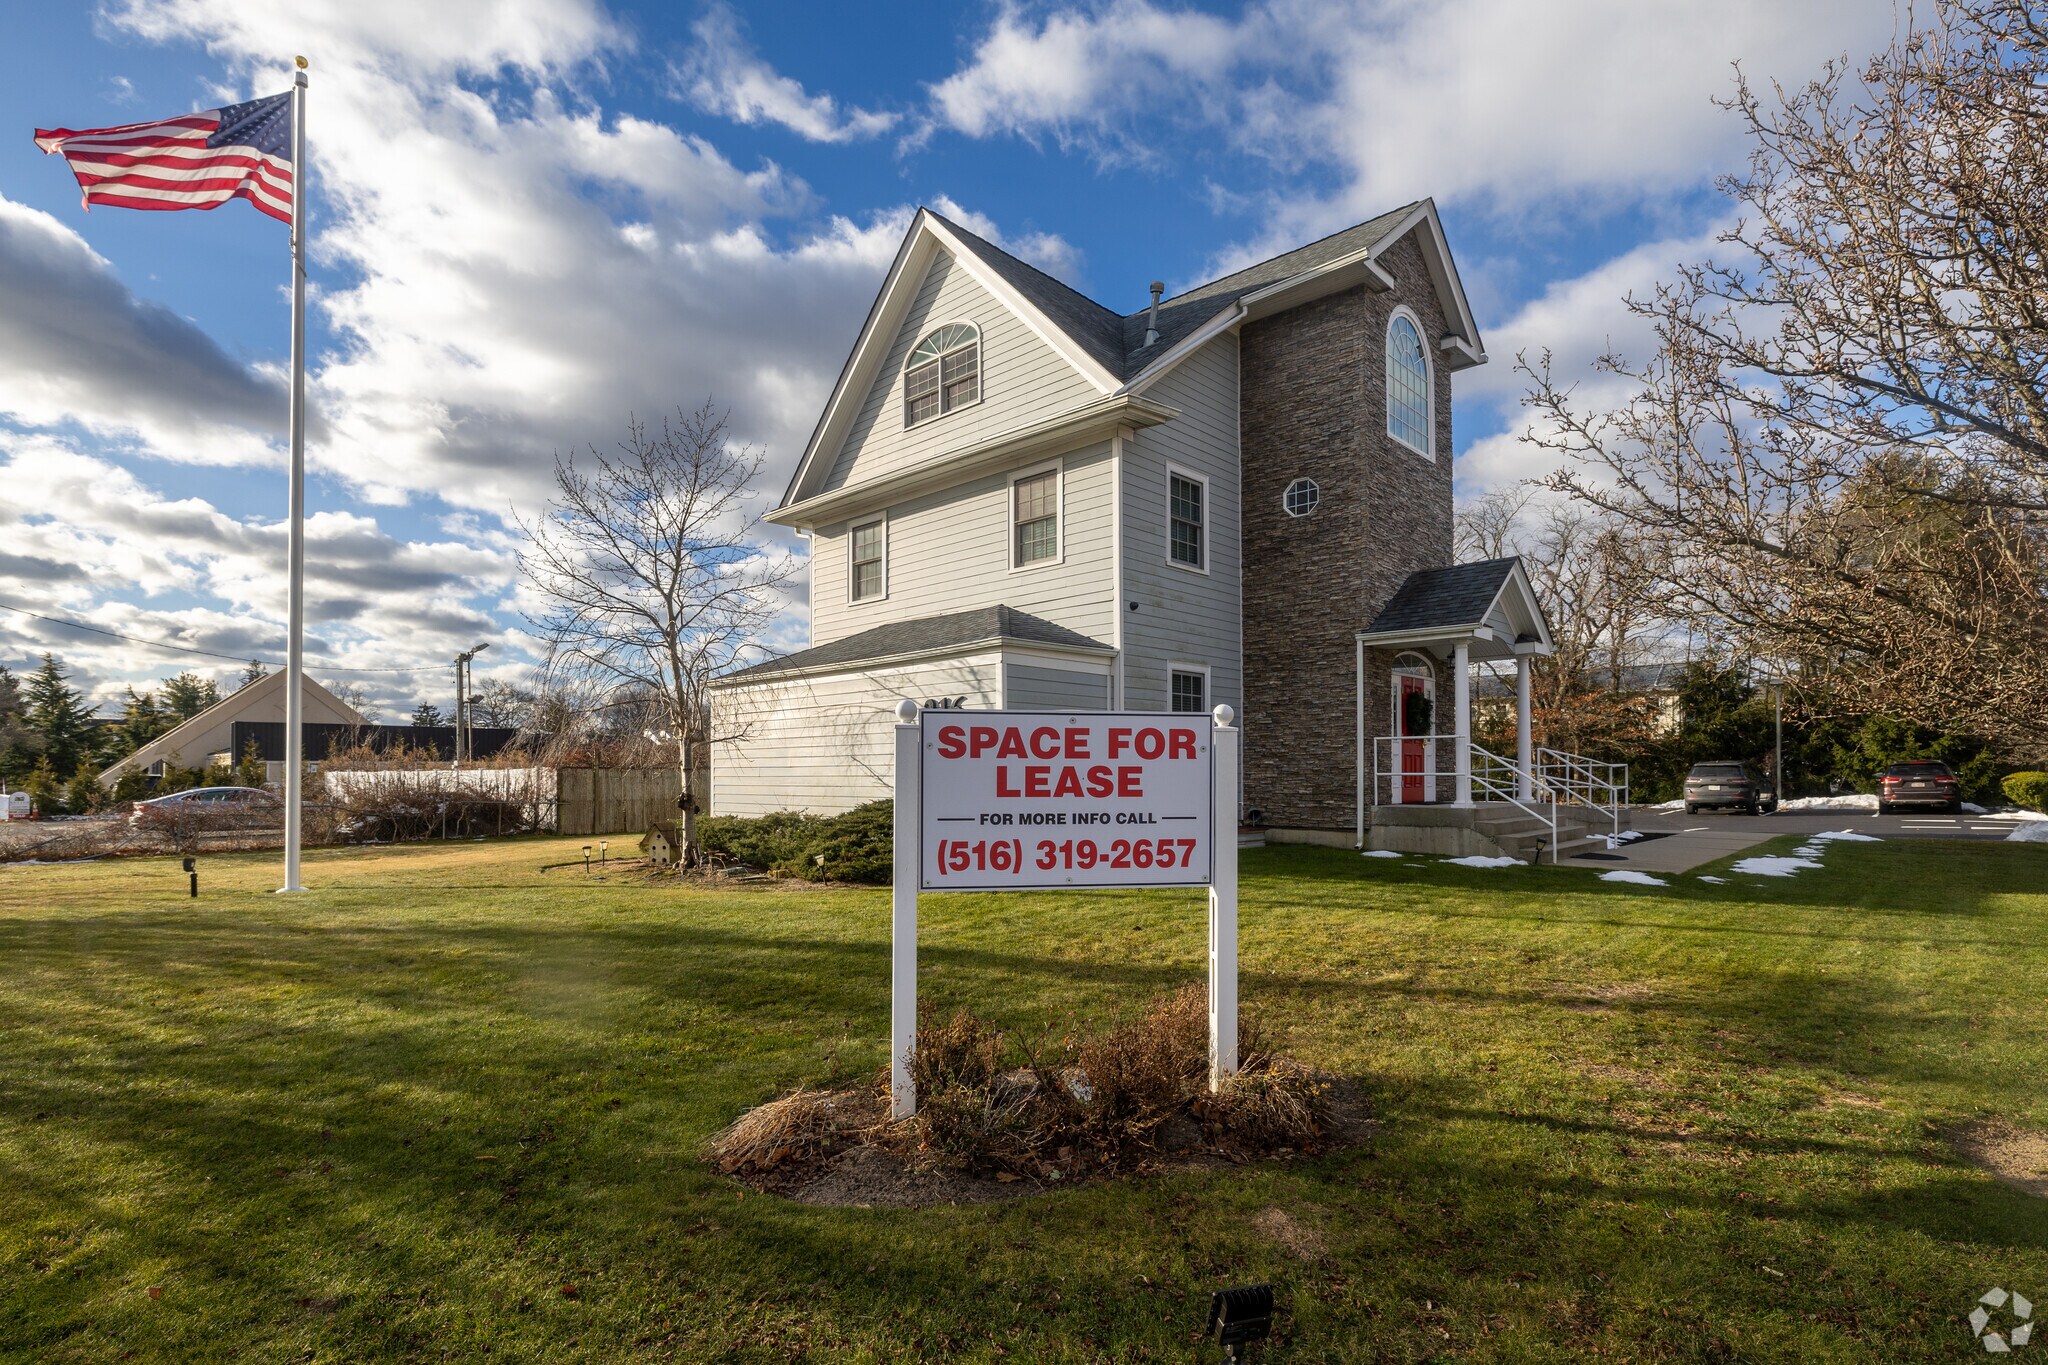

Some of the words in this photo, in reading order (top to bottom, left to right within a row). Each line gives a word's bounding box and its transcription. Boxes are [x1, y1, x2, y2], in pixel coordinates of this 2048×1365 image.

[938, 726, 1091, 759] SPACE
[1108, 727, 1197, 760] FOR
[996, 765, 1144, 798] LEASE
[979, 812, 1014, 826] FOR
[1018, 812, 1067, 826] MORE
[1072, 812, 1111, 825] INFO
[1115, 812, 1158, 825] CALL
[937, 839, 1023, 875] (516)
[1036, 838, 1197, 870] 319-2657
